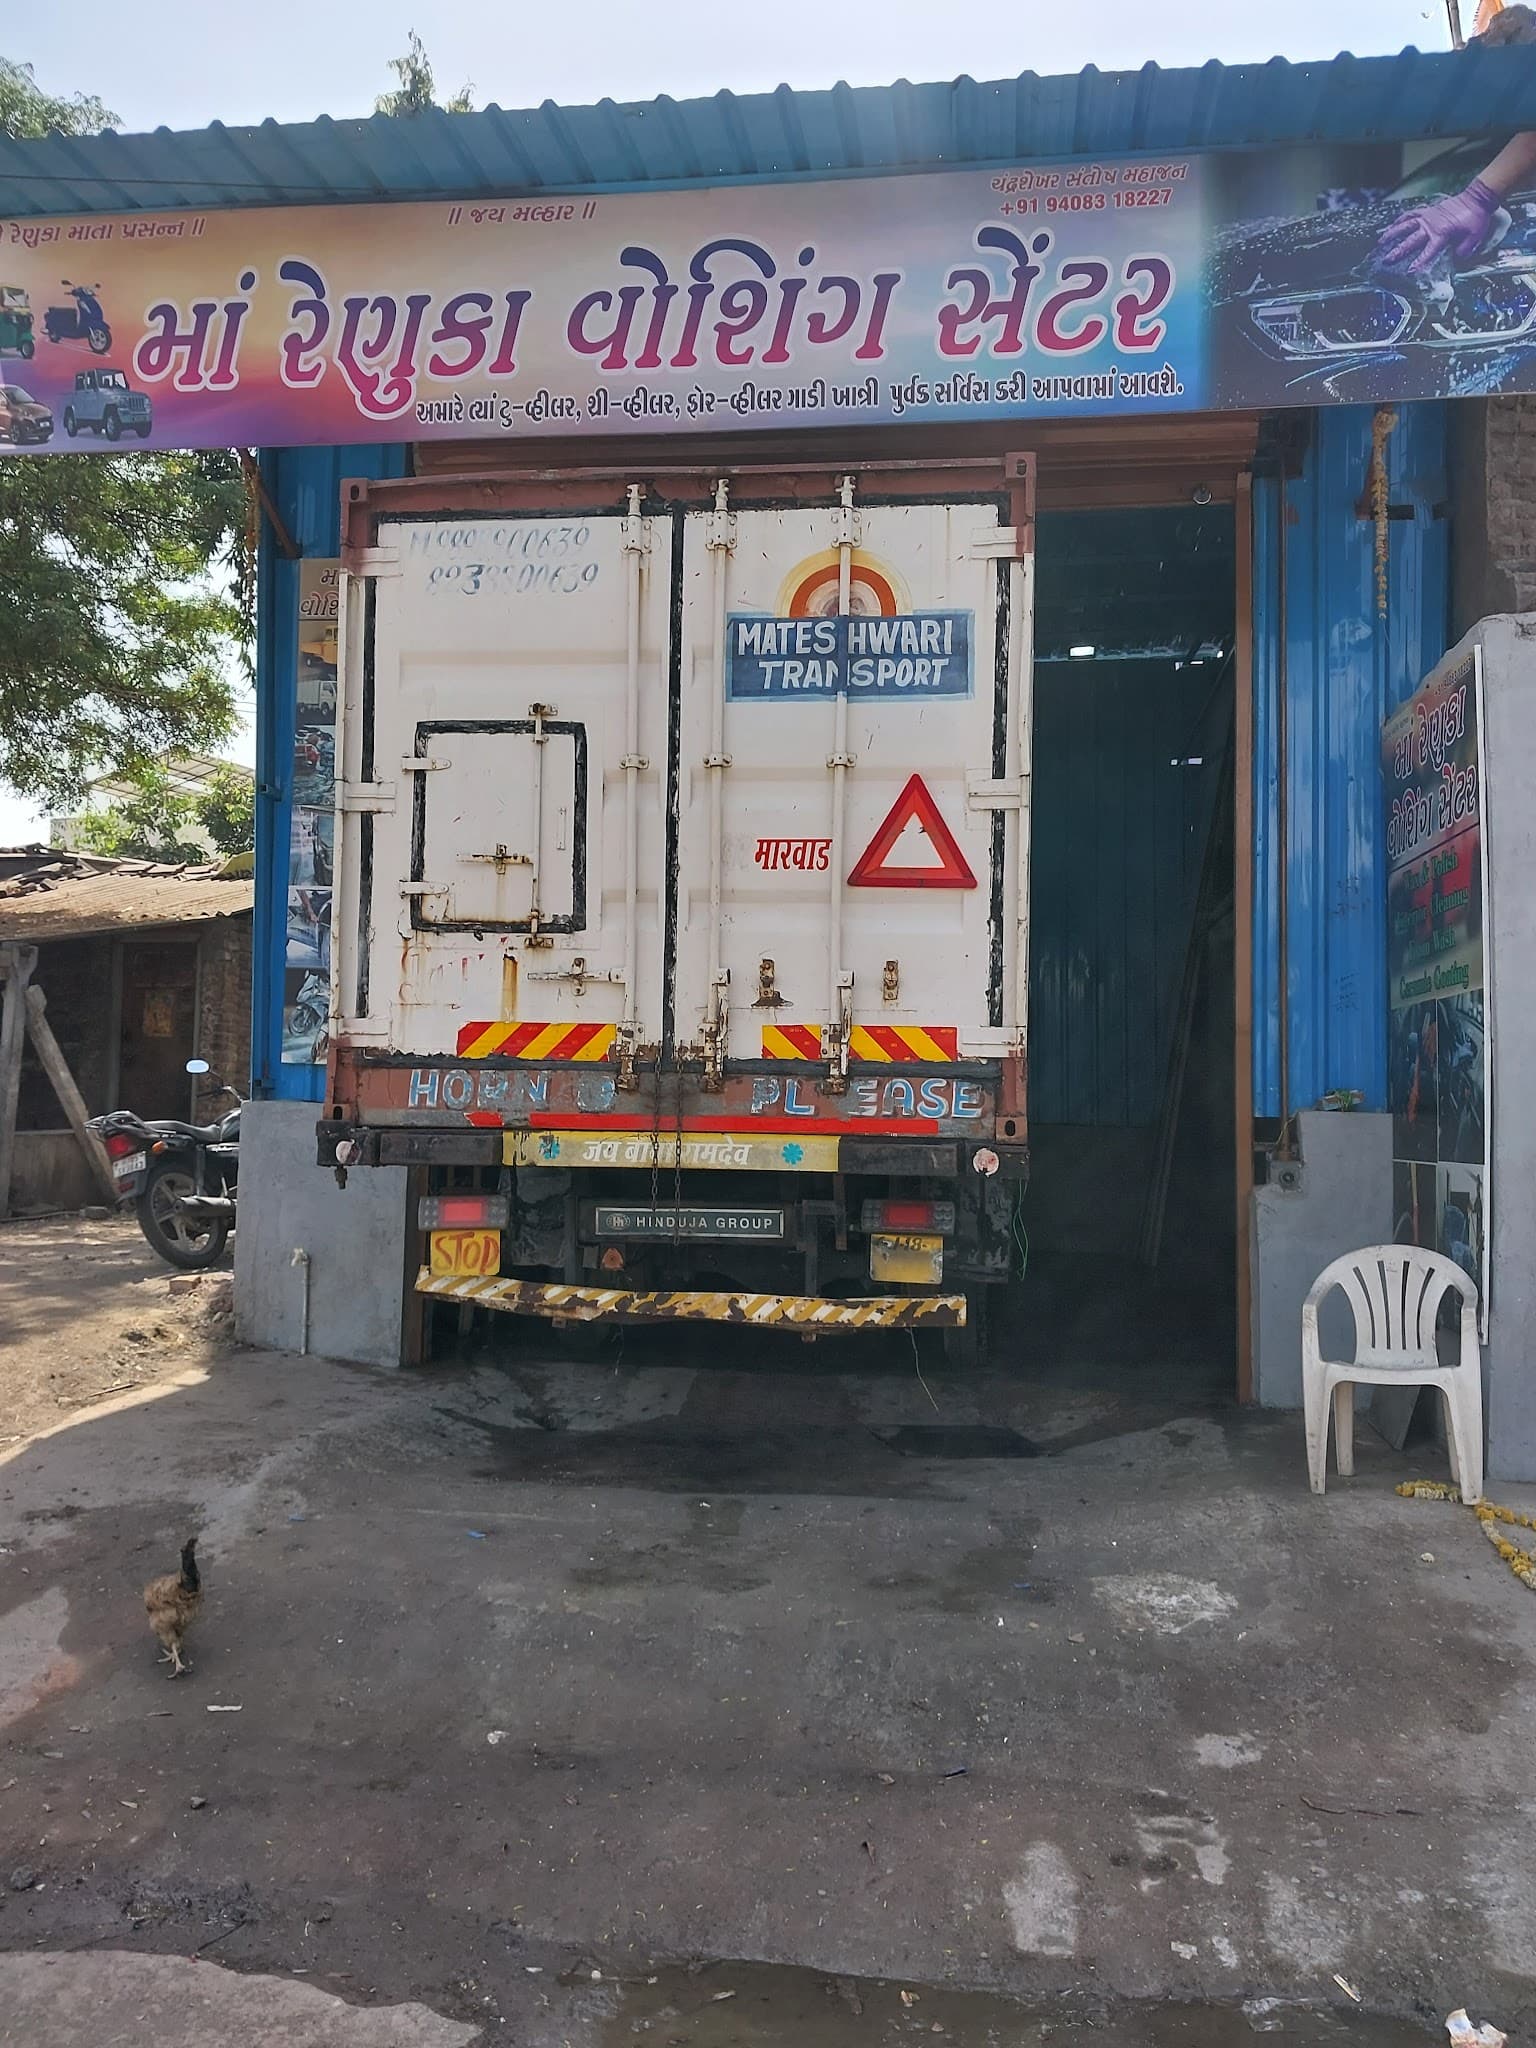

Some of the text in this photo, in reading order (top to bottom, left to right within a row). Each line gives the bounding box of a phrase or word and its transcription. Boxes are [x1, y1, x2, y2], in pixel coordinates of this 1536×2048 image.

[1066, 166, 1118, 188] સંતોષ
[1123, 165, 1188, 183] મહાજન
[470, 208, 506, 224] જય
[512, 205, 575, 222] મલ્હાર
[1001, 189, 1173, 215] +91 94083 18227
[10, 223, 61, 248] રેણુકા
[68, 223, 113, 240] માતા
[122, 220, 185, 238] પ્રસન્ન
[136, 226, 1172, 414] માં રેણુકા વોશિંગ સેંટર
[416, 392, 464, 422] અમારે
[469, 392, 497, 420] ત્યાં
[787, 379, 826, 409] ગાડી
[934, 372, 990, 403] સર્વિસ
[995, 370, 1026, 401] કરી
[1032, 368, 1117, 399] આપવામાં
[758, 658, 949, 689] TRANSPORT
[1416, 684, 1467, 772] રેણુકા
[1387, 761, 1477, 861] વોશિંગ સેંટર
[755, 838, 833, 870] मारवाड
[582, 1141, 623, 1163] जय
[636, 1216, 708, 1229] HINDUJA
[716, 1217, 773, 1230] GROUP
